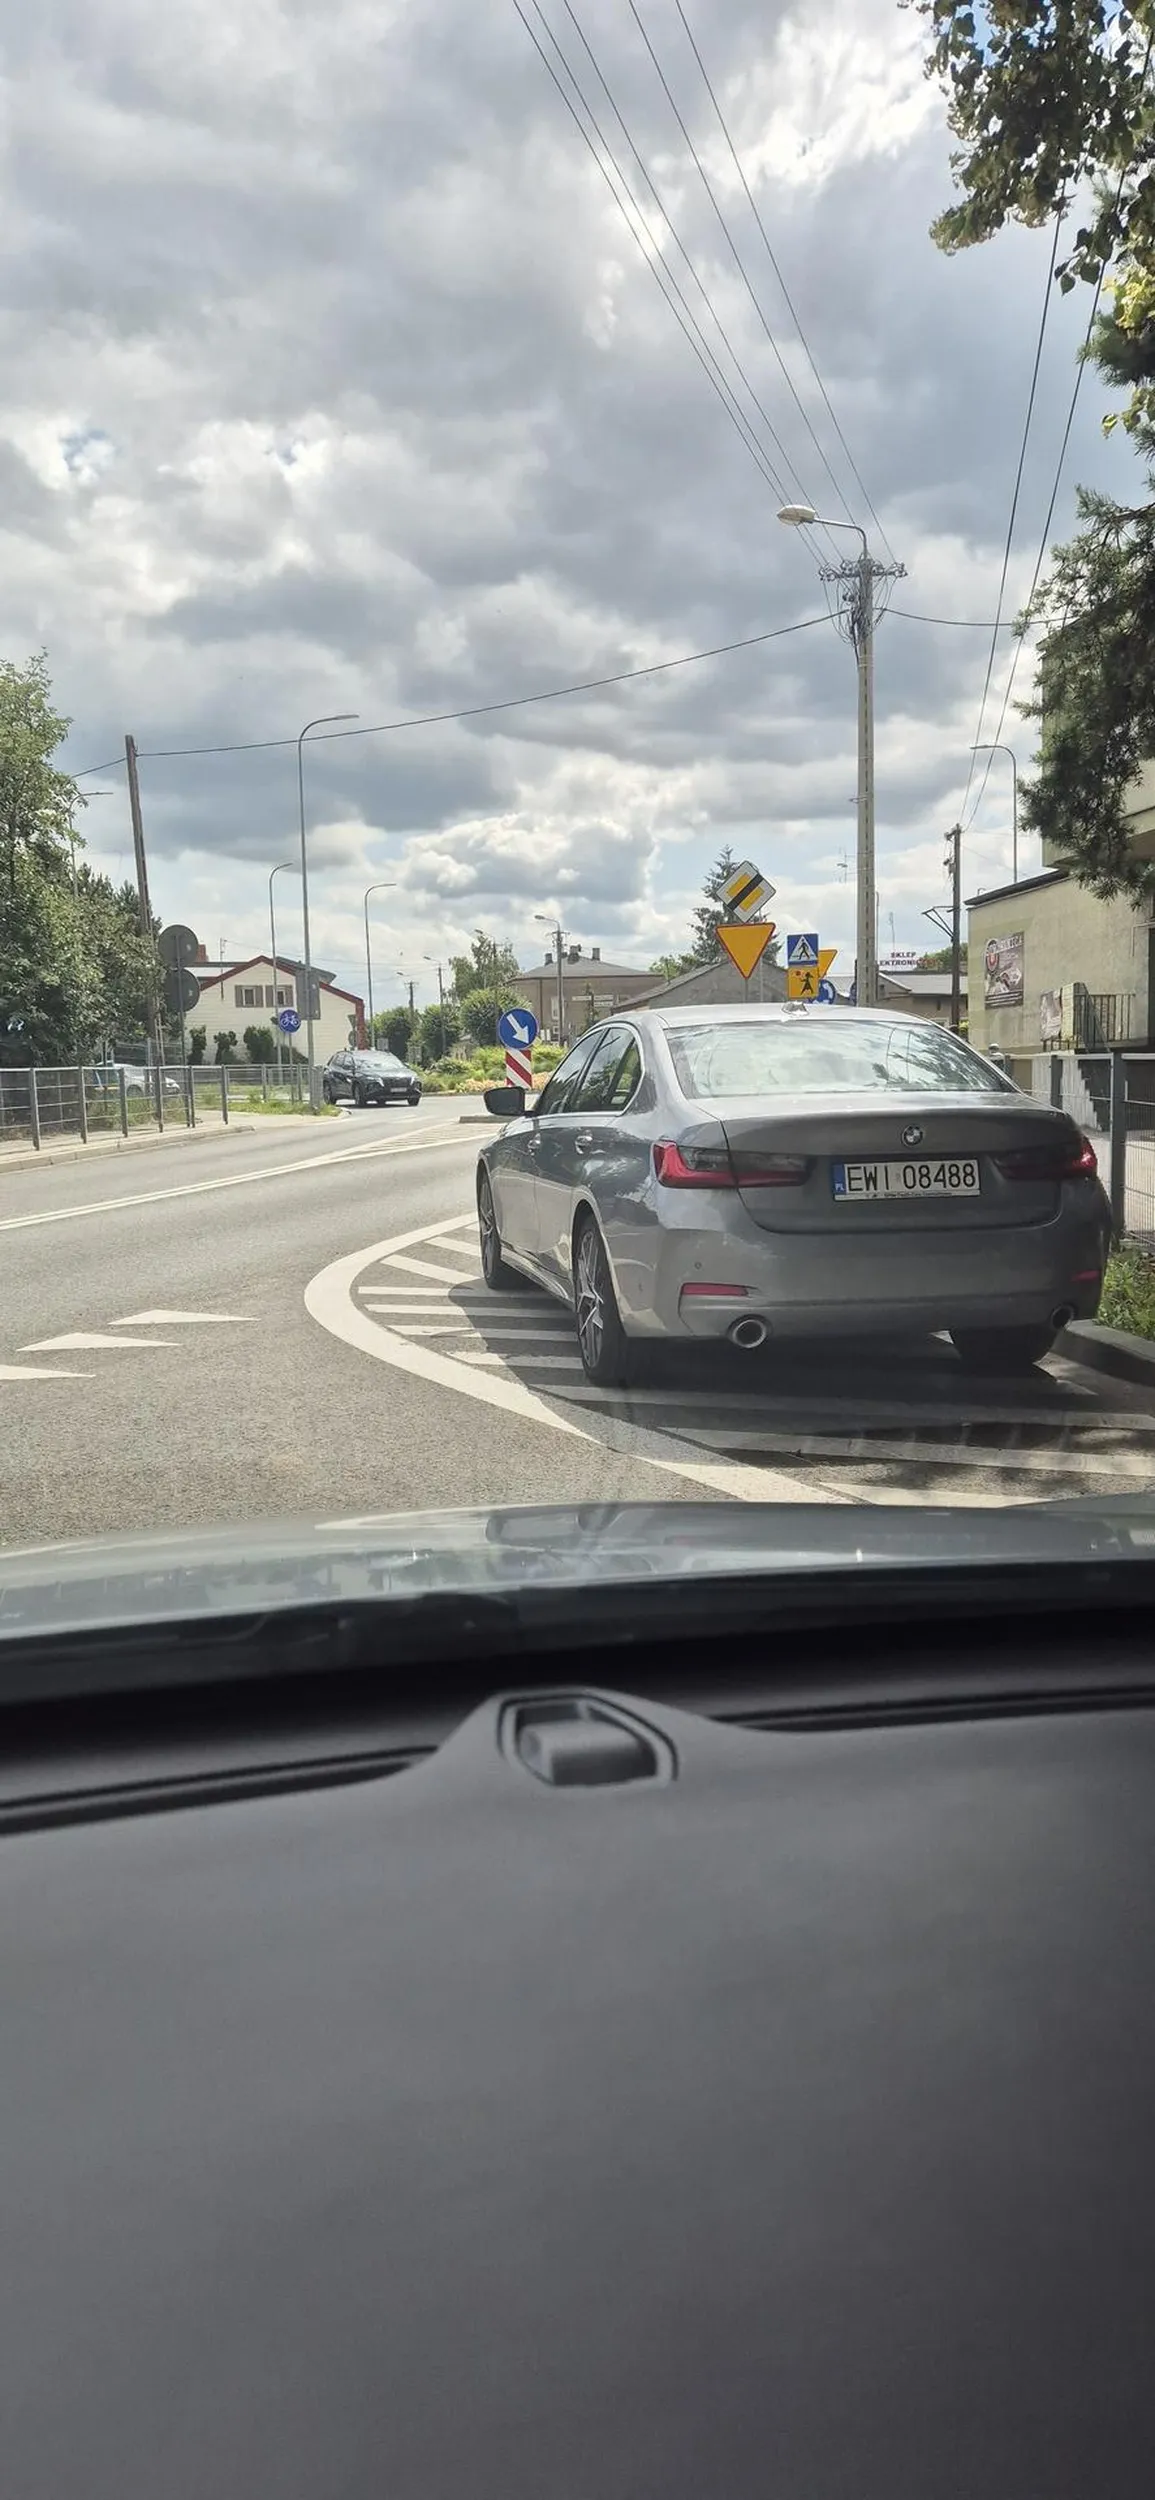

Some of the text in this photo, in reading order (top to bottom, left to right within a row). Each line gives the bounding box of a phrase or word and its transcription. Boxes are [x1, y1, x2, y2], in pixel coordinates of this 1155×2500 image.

[847, 1162, 976, 1192] EWI 08488
[835, 1183, 845, 1192] PL
